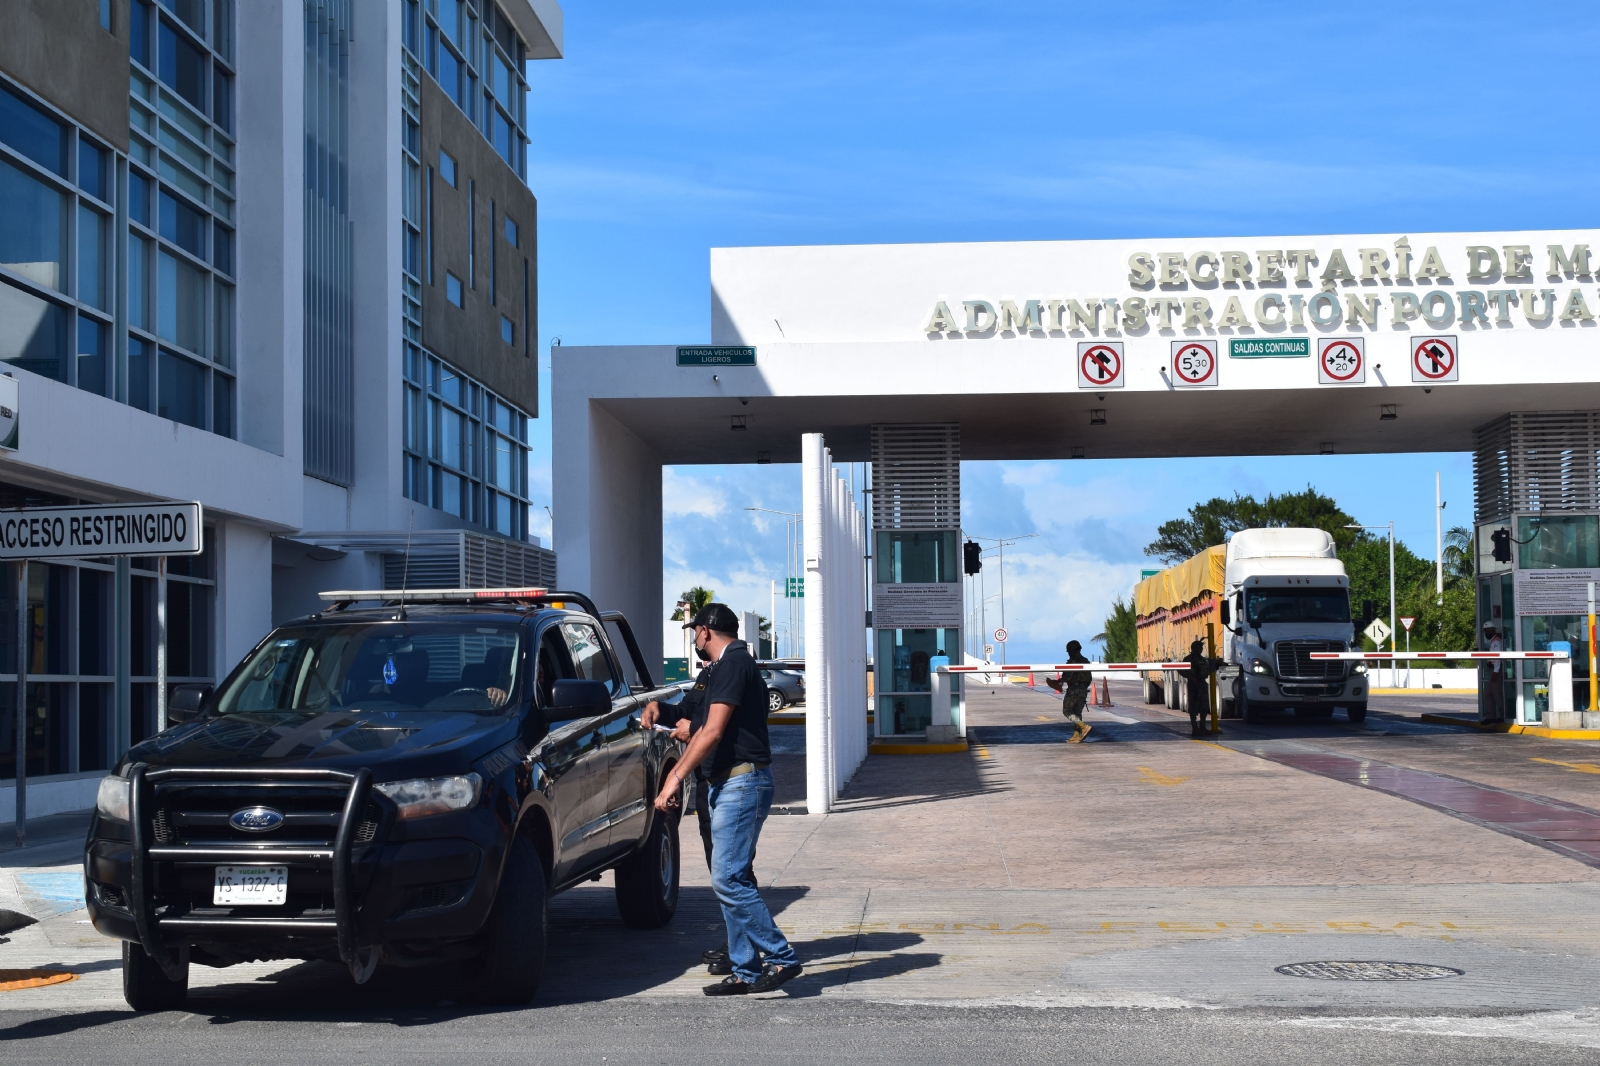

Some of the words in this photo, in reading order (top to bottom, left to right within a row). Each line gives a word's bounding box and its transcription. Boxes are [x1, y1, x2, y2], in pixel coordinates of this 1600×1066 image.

[1128, 236, 1451, 285] SECRETARÍA
[1466, 244, 1531, 277] DE
[1546, 244, 1600, 277] M
[924, 279, 1380, 331] ADMINISTRACIÓN
[1390, 288, 1600, 325] PORTUA
[1234, 343, 1263, 354] SALIDAS
[1265, 342, 1305, 353] CONTINUAS
[1336, 347, 1347, 361] 4
[1182, 357, 1193, 370] 5
[1195, 359, 1207, 368] 30
[1335, 363, 1347, 371] 20
[70, 512, 186, 546] RESTRINGIDO
[241, 811, 271, 826] Ford
[218, 876, 284, 893] YS-1327-C
